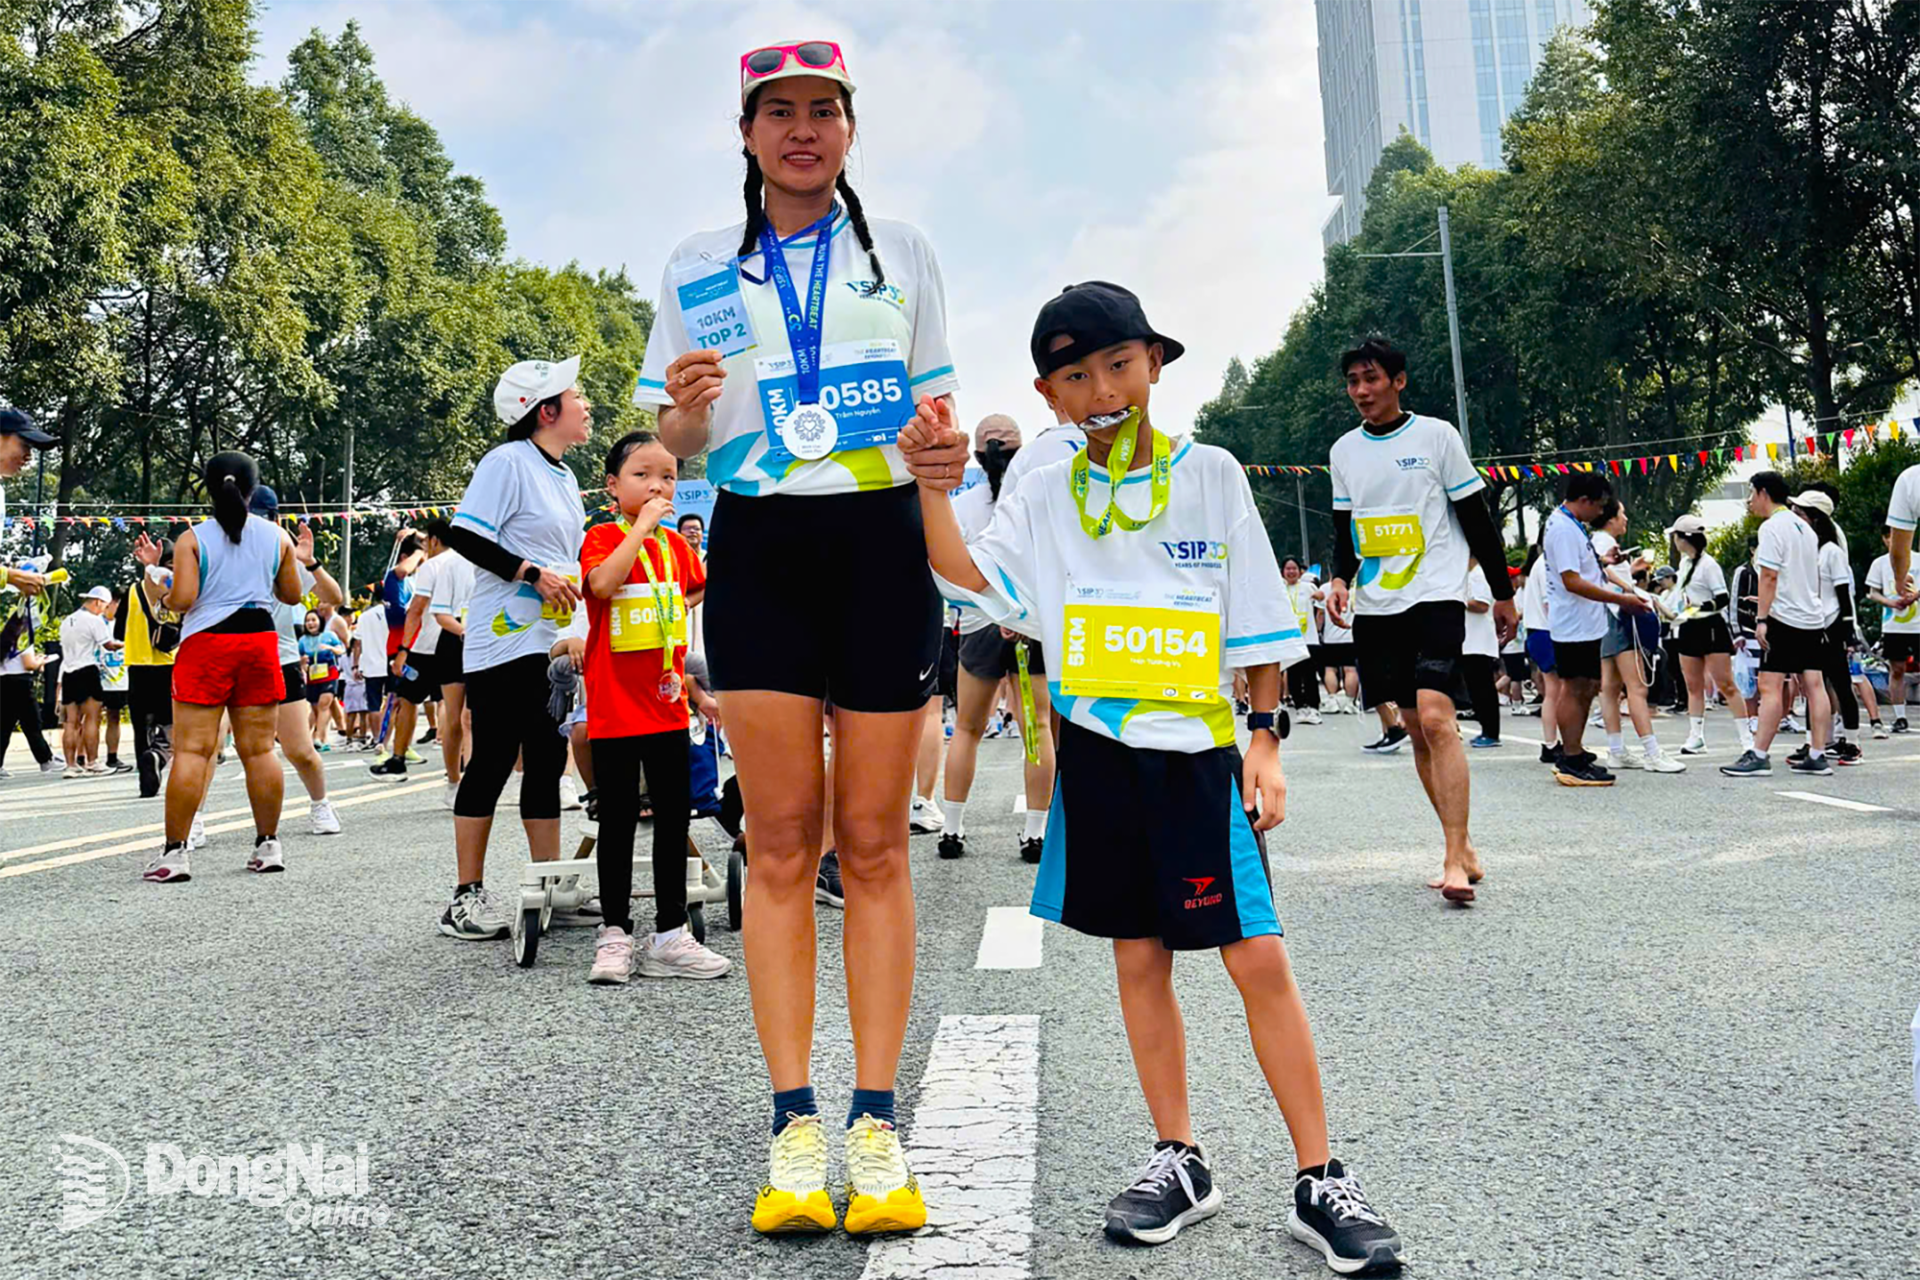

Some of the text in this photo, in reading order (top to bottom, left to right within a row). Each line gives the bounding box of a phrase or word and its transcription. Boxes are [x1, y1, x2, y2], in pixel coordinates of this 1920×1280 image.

[697, 306, 736, 330] 10KM
[697, 322, 747, 350] TOP 2
[1120, 438, 1131, 462] 5KM
[1374, 522, 1414, 537] 51771
[1068, 617, 1086, 667] 5KM
[1104, 625, 1208, 657] 50154
